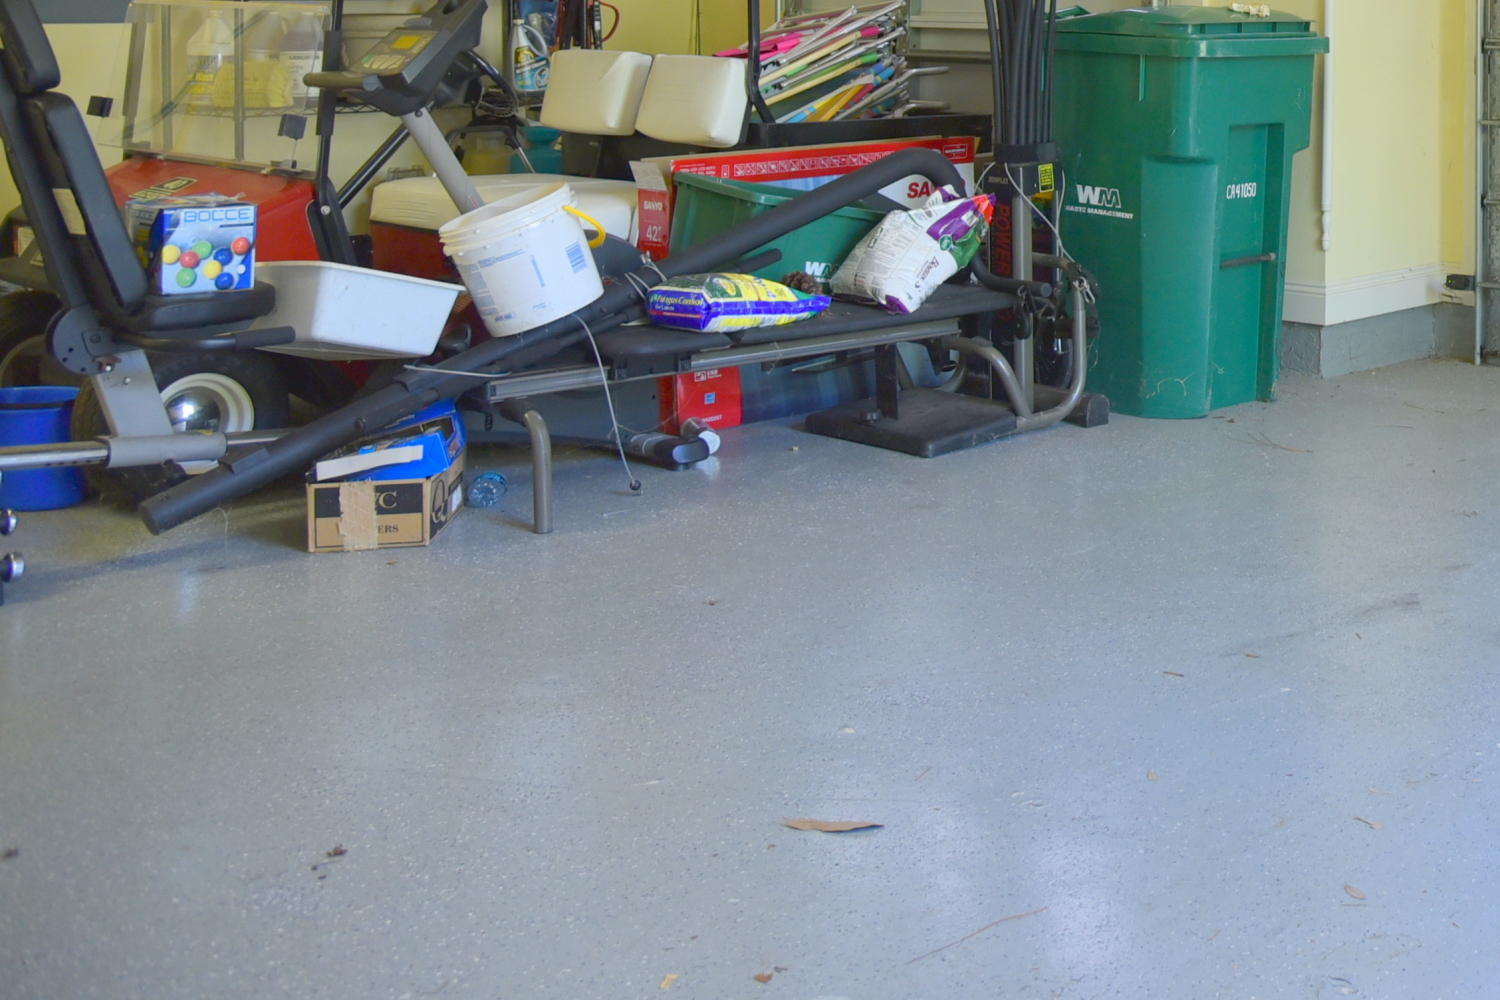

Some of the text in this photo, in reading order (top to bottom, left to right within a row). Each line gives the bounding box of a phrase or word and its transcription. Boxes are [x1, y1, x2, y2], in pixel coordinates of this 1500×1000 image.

[1076, 184, 1122, 209] WM
[183, 208, 251, 223] BOCCE
[1087, 207, 1134, 220] MANAGEMENT
[995, 203, 1012, 276] POWER
